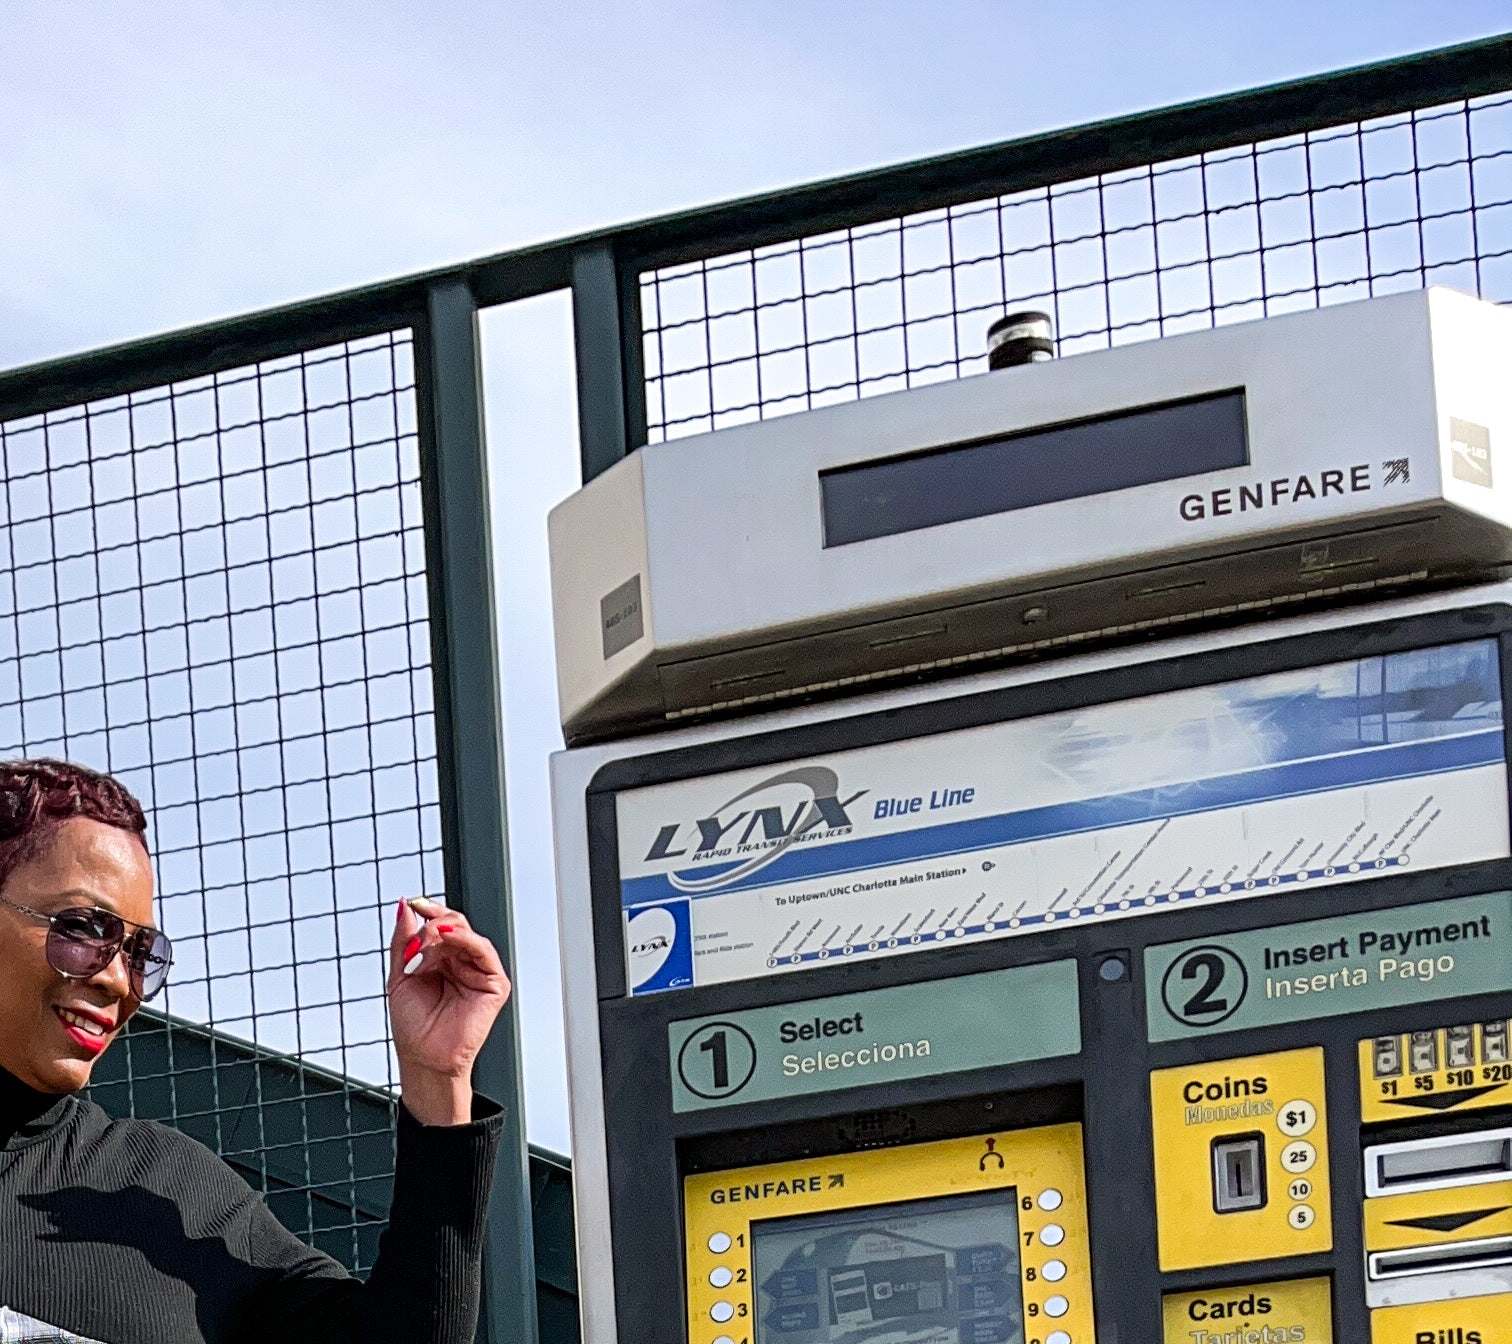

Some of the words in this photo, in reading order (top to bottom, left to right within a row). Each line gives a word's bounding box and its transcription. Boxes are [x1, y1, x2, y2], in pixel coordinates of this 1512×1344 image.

[1180, 464, 1371, 521] GENFARE
[873, 796, 922, 820] Blue
[929, 786, 975, 810] Line
[644, 789, 870, 862] LYNX
[692, 847, 732, 862] RAPID
[792, 826, 853, 845] SERVICES
[900, 873, 924, 888] Main
[926, 869, 961, 883] Station
[1264, 936, 1349, 970] Insert
[1359, 915, 1491, 955] Payment
[1181, 953, 1228, 1017] 2
[1265, 965, 1368, 1000] Inserta
[1378, 954, 1455, 983] Pago
[779, 1012, 864, 1044] Select
[699, 1030, 729, 1089] 1
[782, 1037, 931, 1077] Selecciona
[1183, 1075, 1268, 1104] Coins
[1381, 1079, 1398, 1096] $1
[1414, 1075, 1434, 1091] $5
[1446, 1069, 1474, 1087] $10
[1482, 1063, 1512, 1083] $20
[1184, 1098, 1275, 1126] Monedas
[1285, 1109, 1307, 1128] $1
[1290, 1150, 1308, 1164] 25
[710, 1176, 822, 1204] GENFARE
[1021, 1195, 1033, 1211] 6
[1291, 1184, 1308, 1196] 10
[1297, 1211, 1306, 1223] 5
[1023, 1231, 1033, 1246] 7
[736, 1268, 748, 1283] 2
[1025, 1266, 1037, 1282] 8
[737, 1303, 748, 1318] 3
[1027, 1302, 1039, 1318] 9
[1188, 1294, 1272, 1322] Cards
